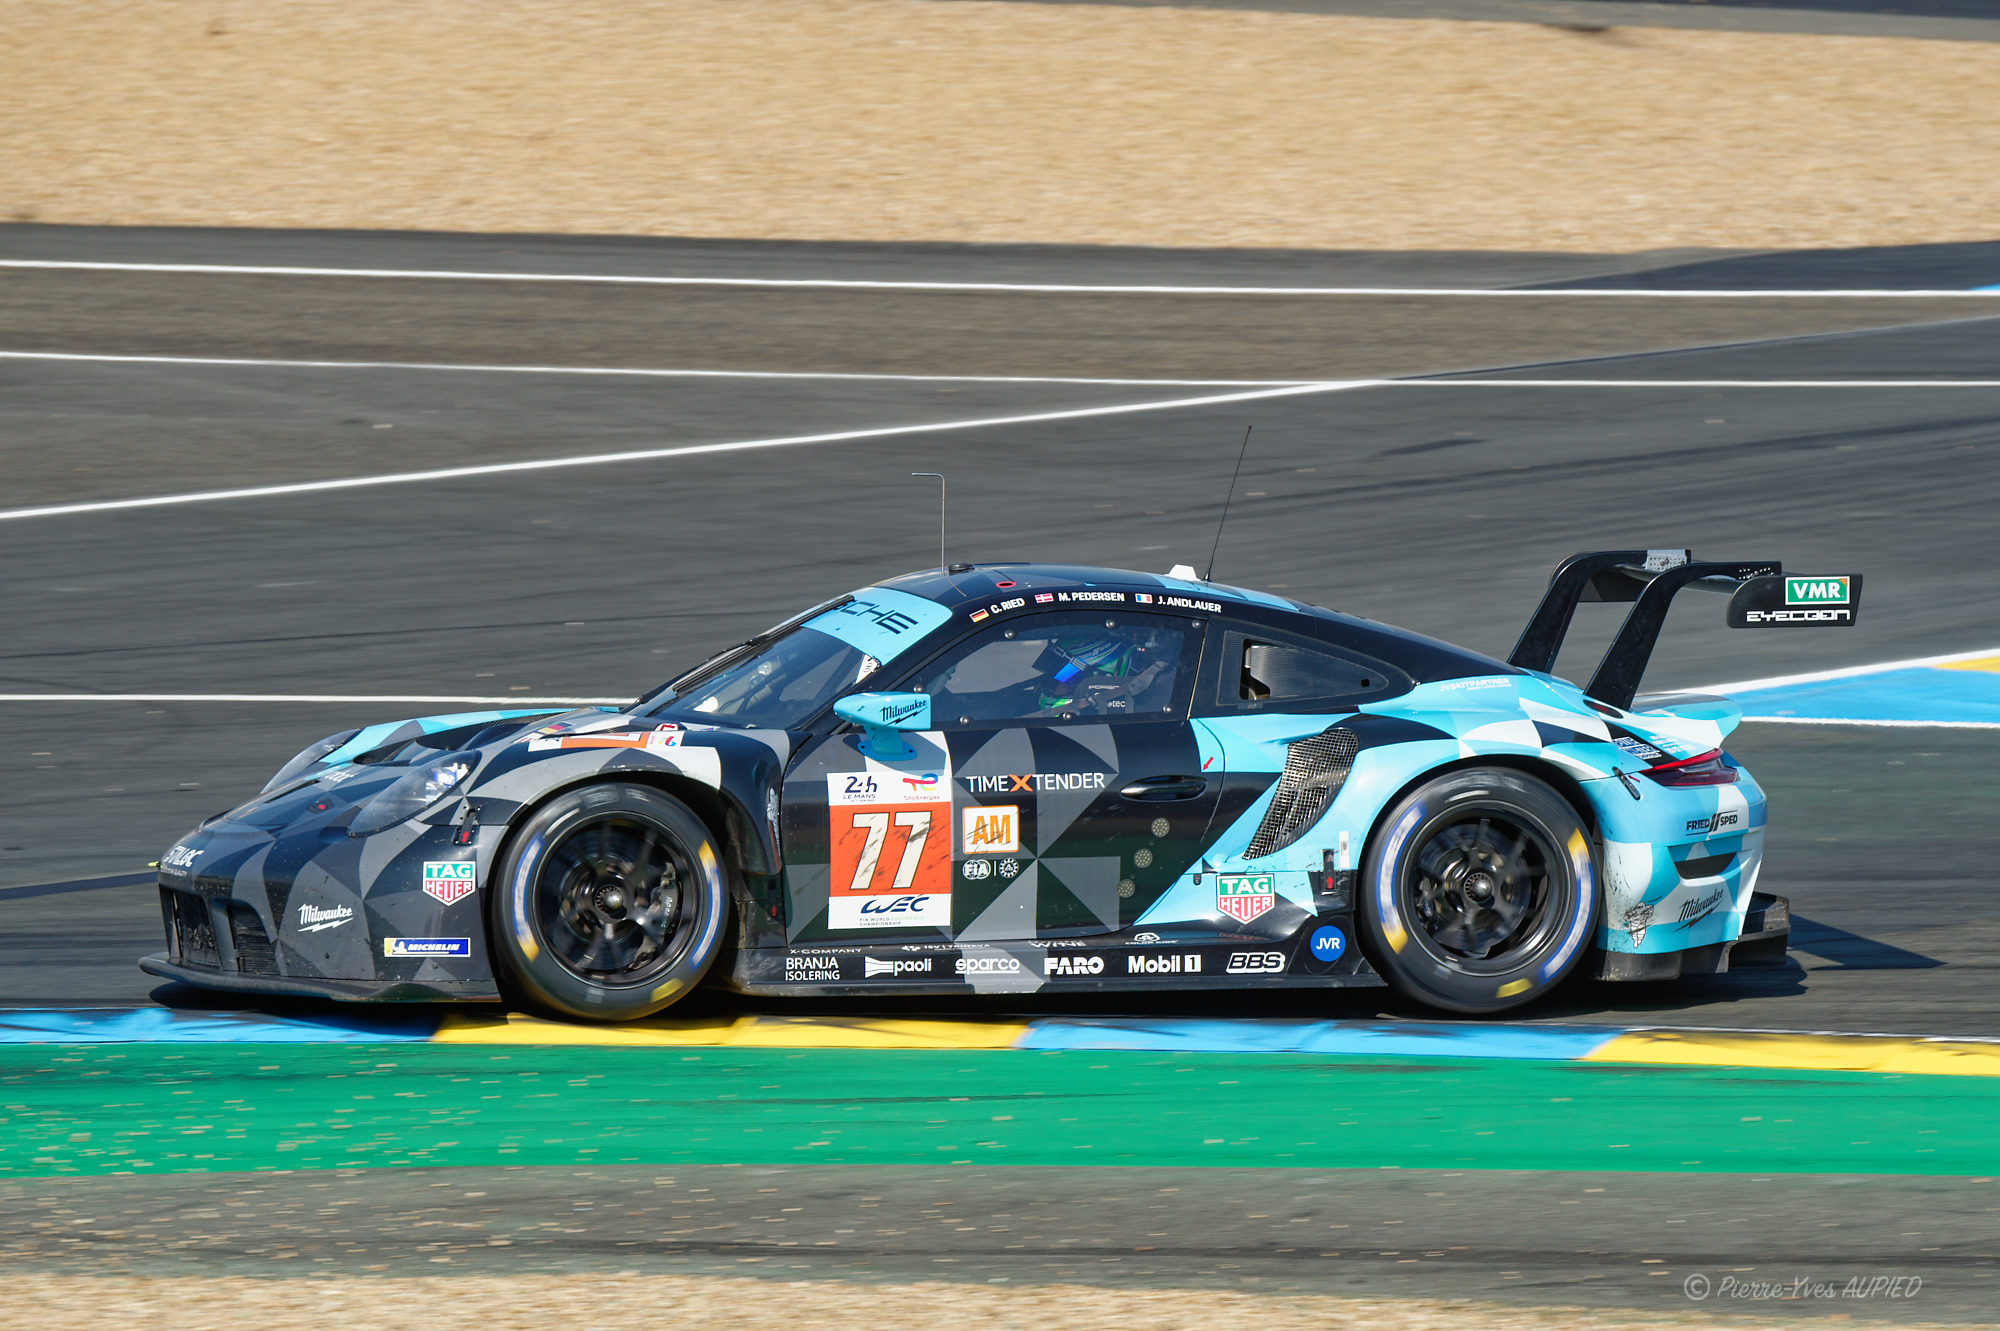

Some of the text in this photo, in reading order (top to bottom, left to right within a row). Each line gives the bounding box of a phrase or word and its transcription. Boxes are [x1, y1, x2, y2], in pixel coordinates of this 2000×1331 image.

[1793, 582, 1841, 599] VMR
[879, 699, 927, 722] Milwaukee
[972, 814, 1012, 845] AM
[1686, 814, 1738, 831] FRIED SPED
[849, 810, 933, 891] 77
[427, 864, 471, 878] TAG
[426, 881, 472, 902] HEUER
[1221, 878, 1270, 894] TAG
[860, 896, 930, 914] WEC
[1221, 896, 1271, 922] HEUER
[1678, 888, 1724, 923] Milwaukee
[298, 903, 354, 926] Milwaukee
[407, 943, 461, 952] MICHELIN
[1315, 937, 1340, 950] JVR
[785, 956, 839, 970] BRANJA
[893, 957, 932, 977] paoli
[955, 957, 1021, 974] sparco
[1043, 956, 1105, 975] FARO
[1128, 955, 1181, 973] Mobil
[1228, 953, 1284, 971] BBS
[785, 969, 840, 981] ISOLERING
